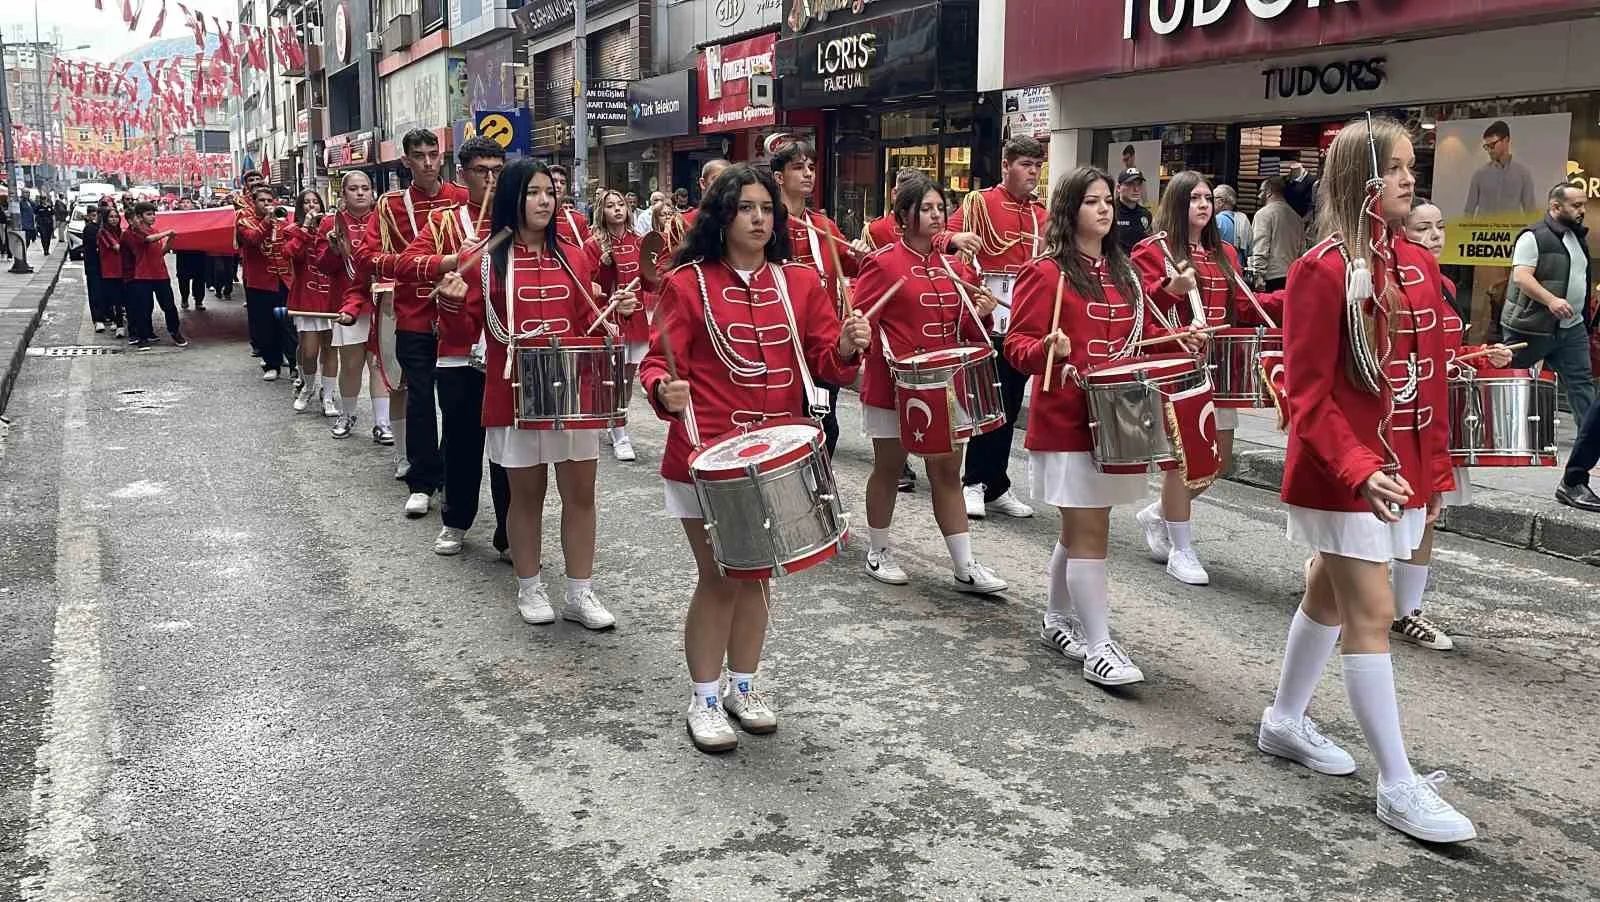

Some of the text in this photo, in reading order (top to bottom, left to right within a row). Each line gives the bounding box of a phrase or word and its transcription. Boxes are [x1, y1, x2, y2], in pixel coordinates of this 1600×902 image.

[817, 34, 870, 74] LORIS
[824, 74, 863, 92] PARFUM
[1262, 57, 1386, 99] TUDORS
[641, 98, 679, 117] Türk Telekom
[1466, 244, 1514, 258] BEDAV
